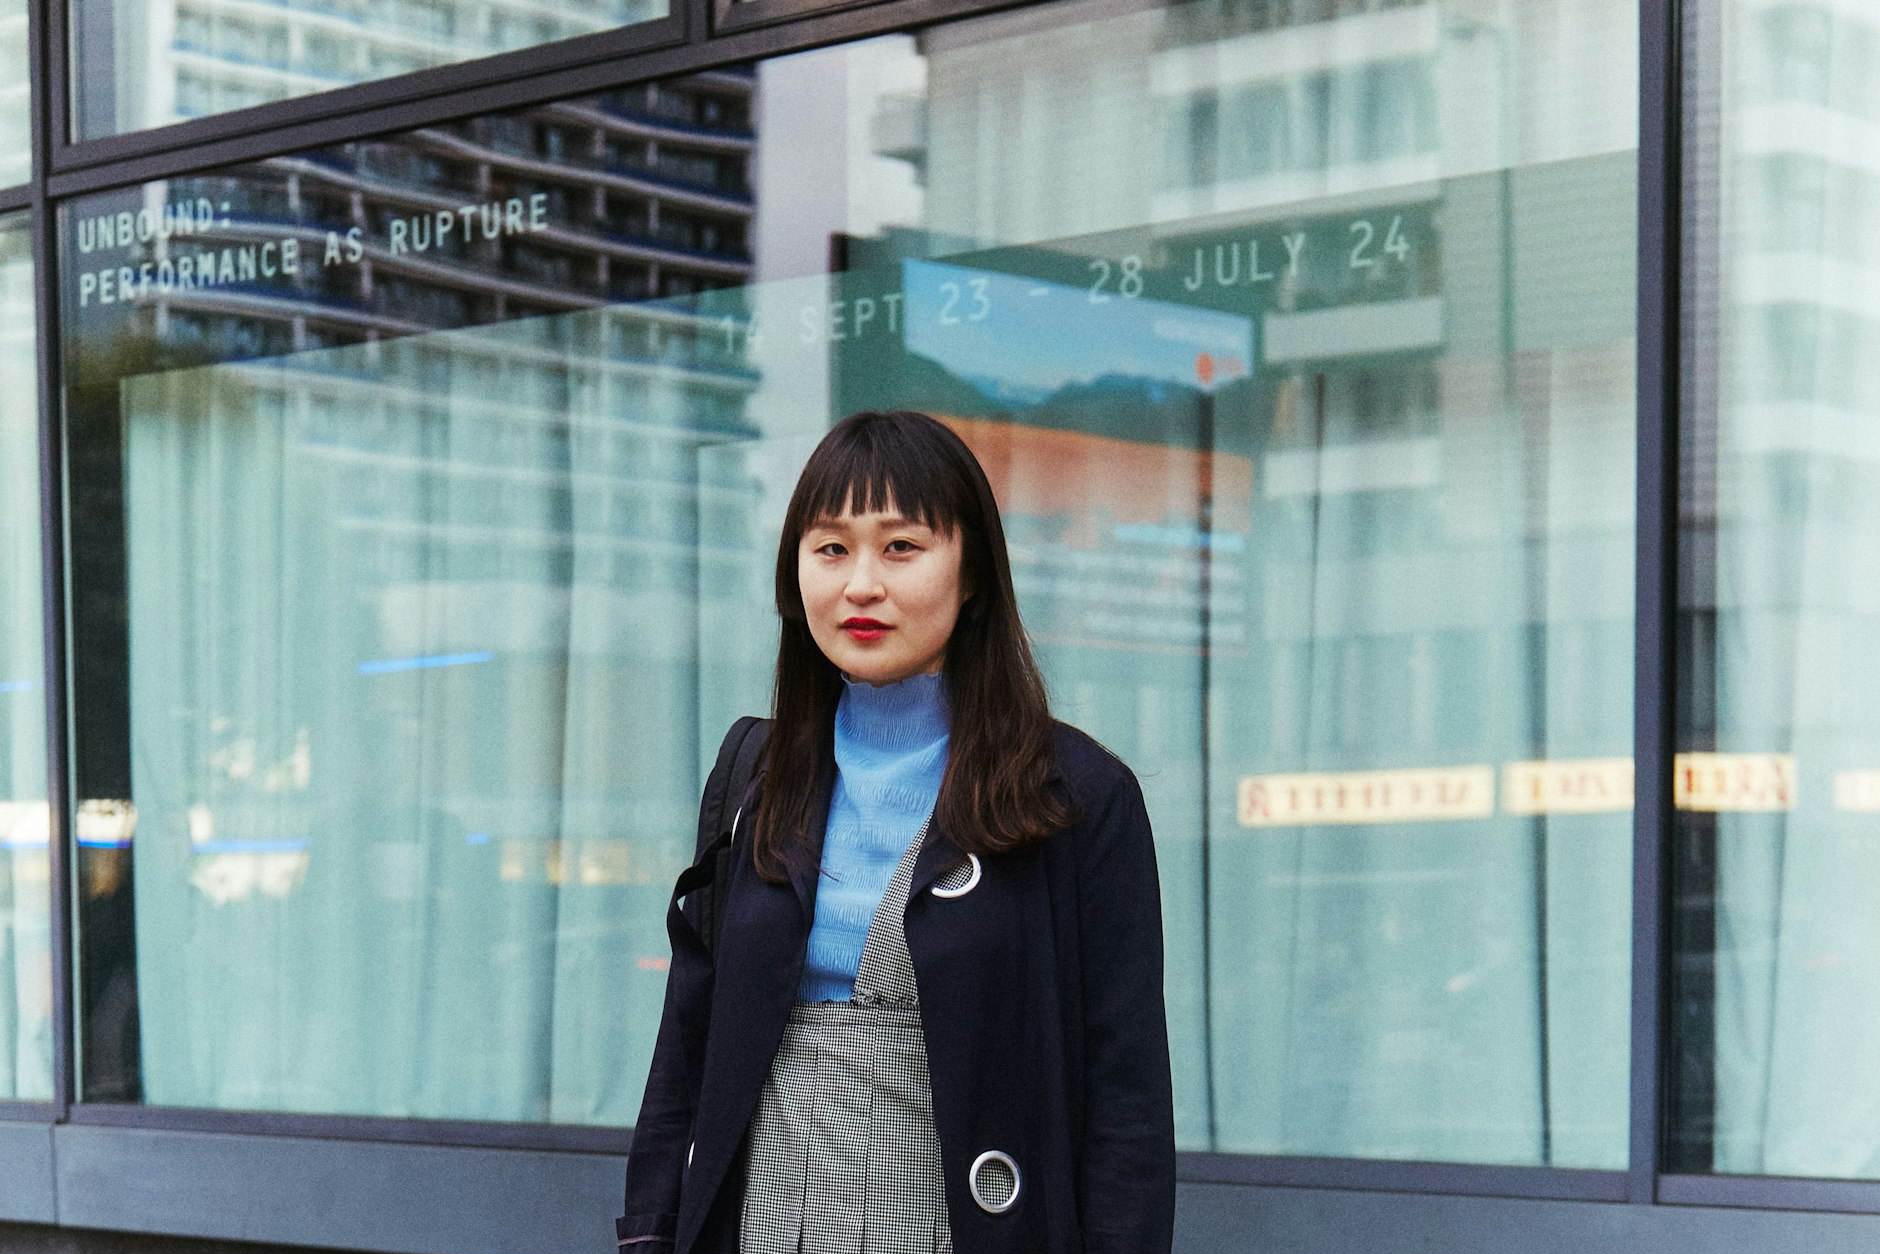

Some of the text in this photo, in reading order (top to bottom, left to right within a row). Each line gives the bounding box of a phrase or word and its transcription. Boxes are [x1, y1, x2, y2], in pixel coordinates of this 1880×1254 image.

[78, 197, 231, 254] UNBOUND:
[79, 192, 549, 308] PERFORMANCE AS RUPTURE
[800, 292, 902, 344] SEPT
[938, 276, 992, 326] 23
[1088, 254, 1144, 304] 28
[1183, 232, 1306, 292] JULY
[1349, 215, 1411, 269] 24
